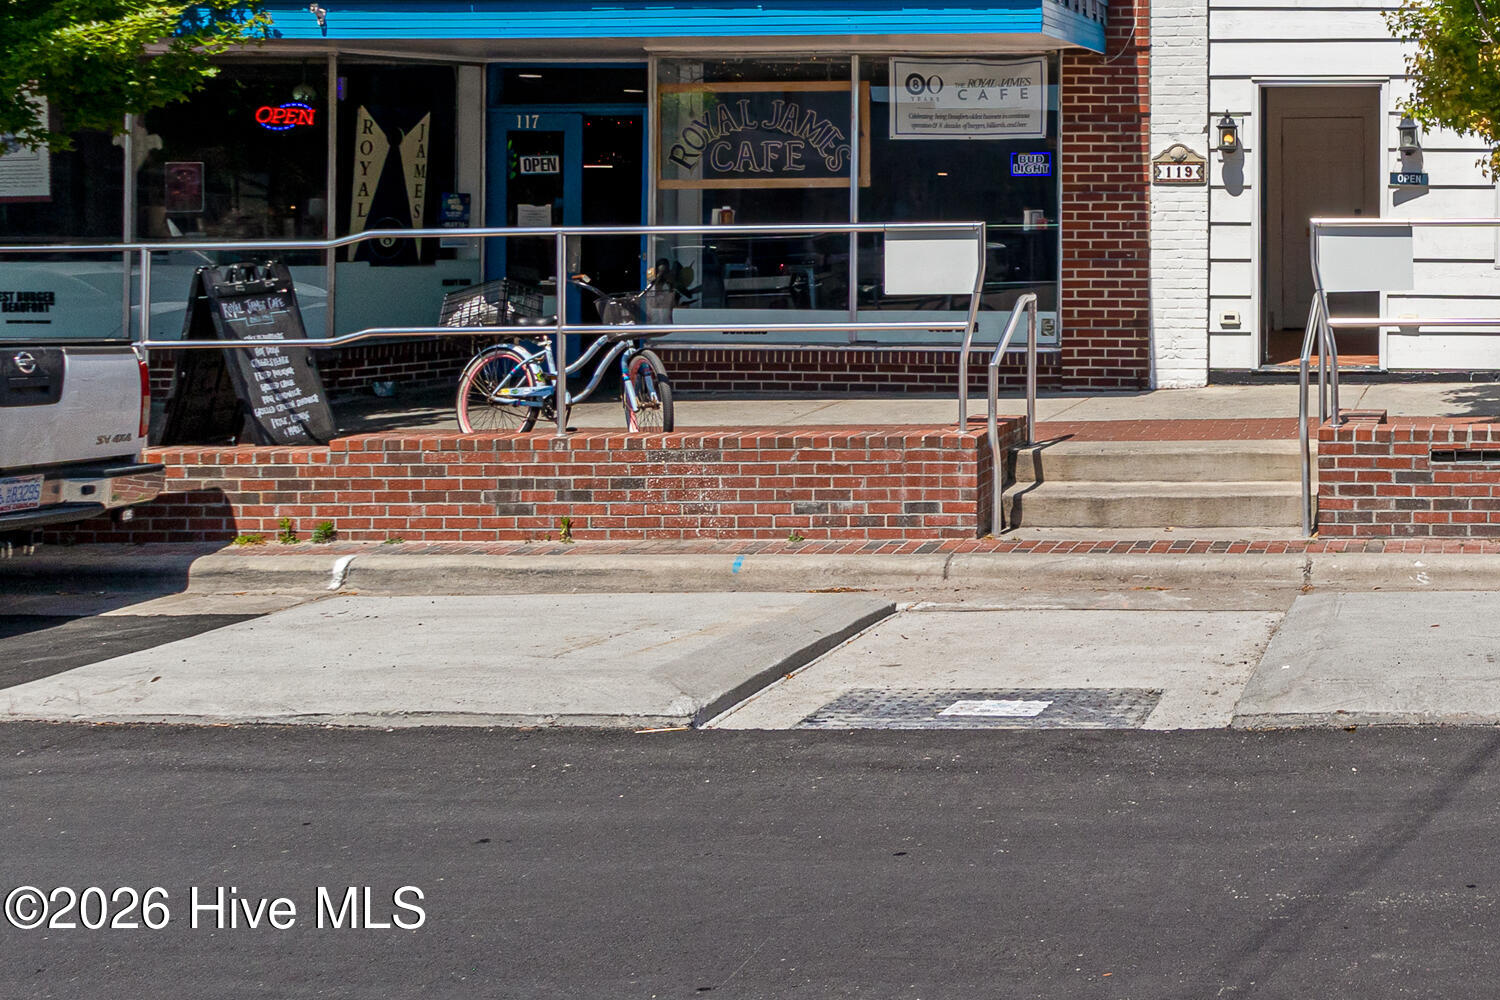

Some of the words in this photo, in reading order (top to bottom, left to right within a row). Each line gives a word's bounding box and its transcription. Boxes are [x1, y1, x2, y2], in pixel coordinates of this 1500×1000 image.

[967, 78, 996, 88] ROYAL
[998, 77, 1032, 88] JAMES
[957, 88, 1029, 101] CAFE
[255, 105, 316, 126] OPEN
[517, 114, 540, 129] 117
[668, 99, 758, 171] ROYAL
[761, 99, 851, 172] JAMES
[523, 157, 557, 172] OPEN
[710, 141, 806, 173] CAFE
[1017, 154, 1045, 164] BUD
[358, 119, 374, 218] ROYAL
[413, 124, 426, 219] JAMES
[1013, 163, 1050, 174] LIGHT
[1166, 166, 1193, 178] 119
[1397, 174, 1422, 184] OPEN
